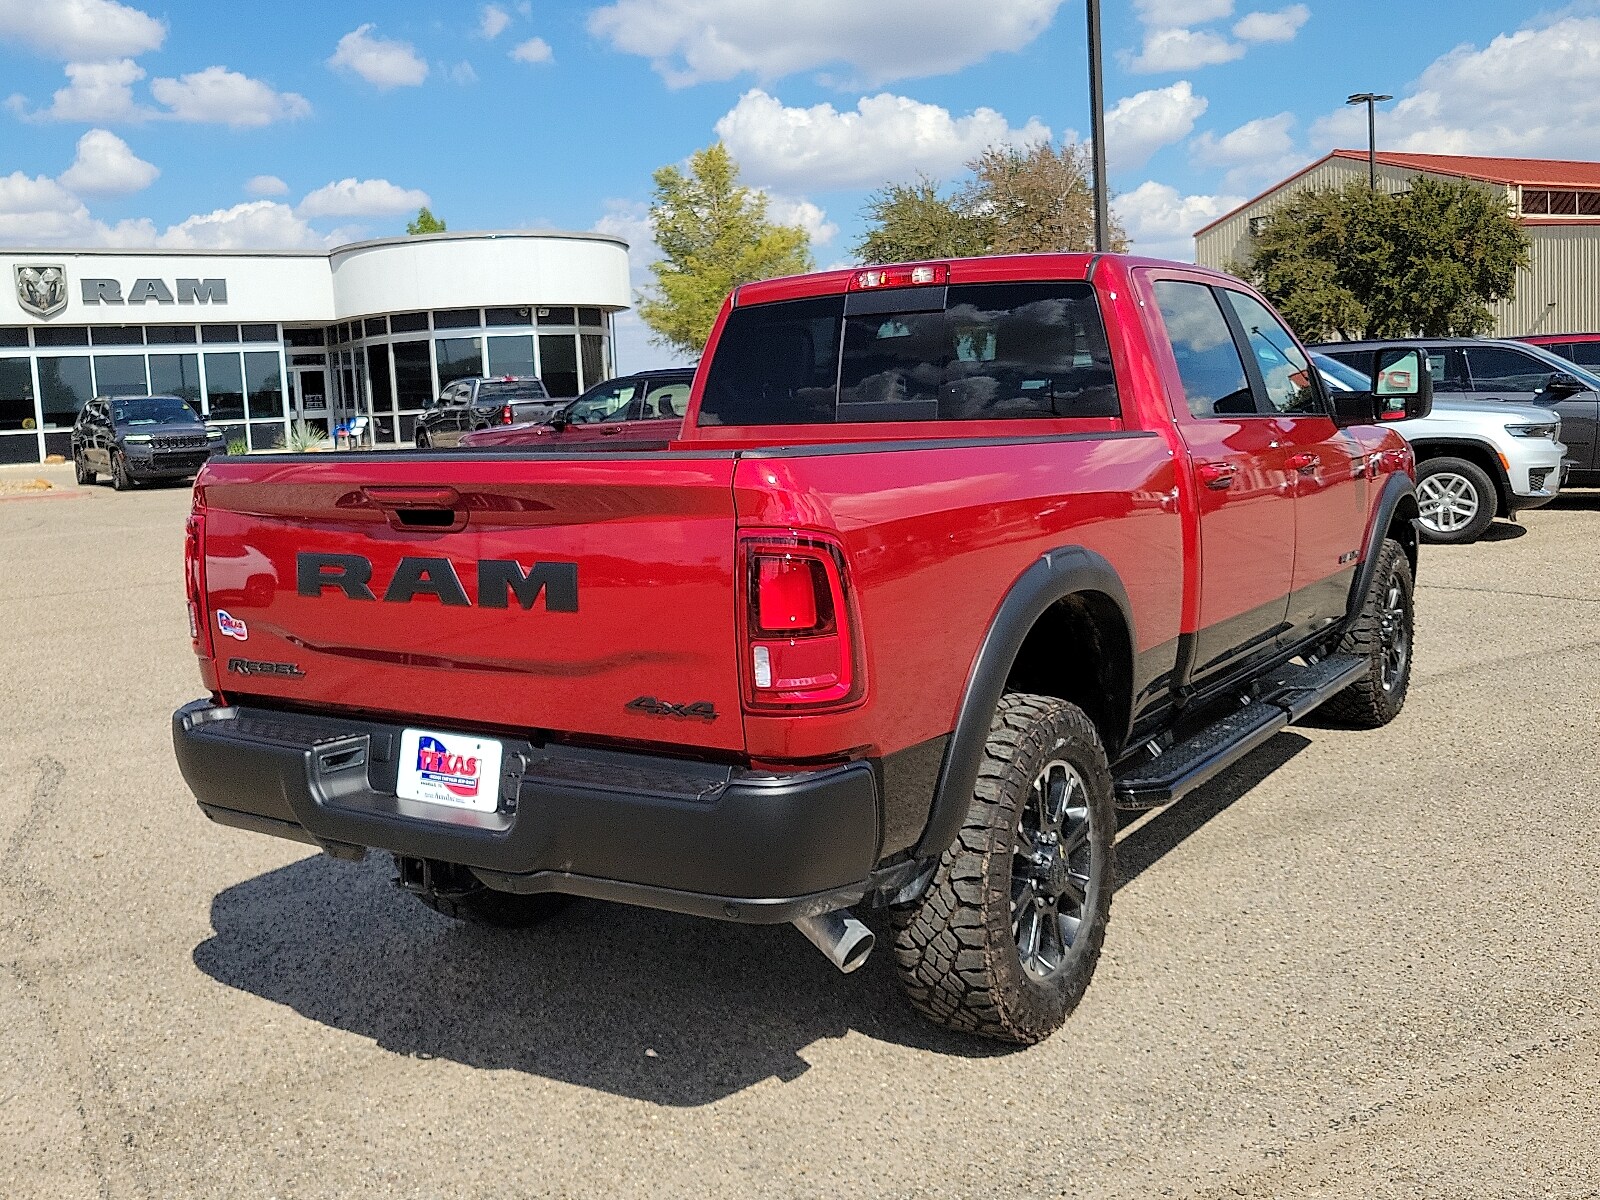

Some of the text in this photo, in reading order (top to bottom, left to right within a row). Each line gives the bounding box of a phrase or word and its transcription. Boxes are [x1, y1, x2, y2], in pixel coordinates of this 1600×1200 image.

[80, 278, 228, 305] RAM
[297, 552, 578, 613] RAM
[228, 659, 306, 677] REBEL
[420, 749, 477, 776] TEXAS
